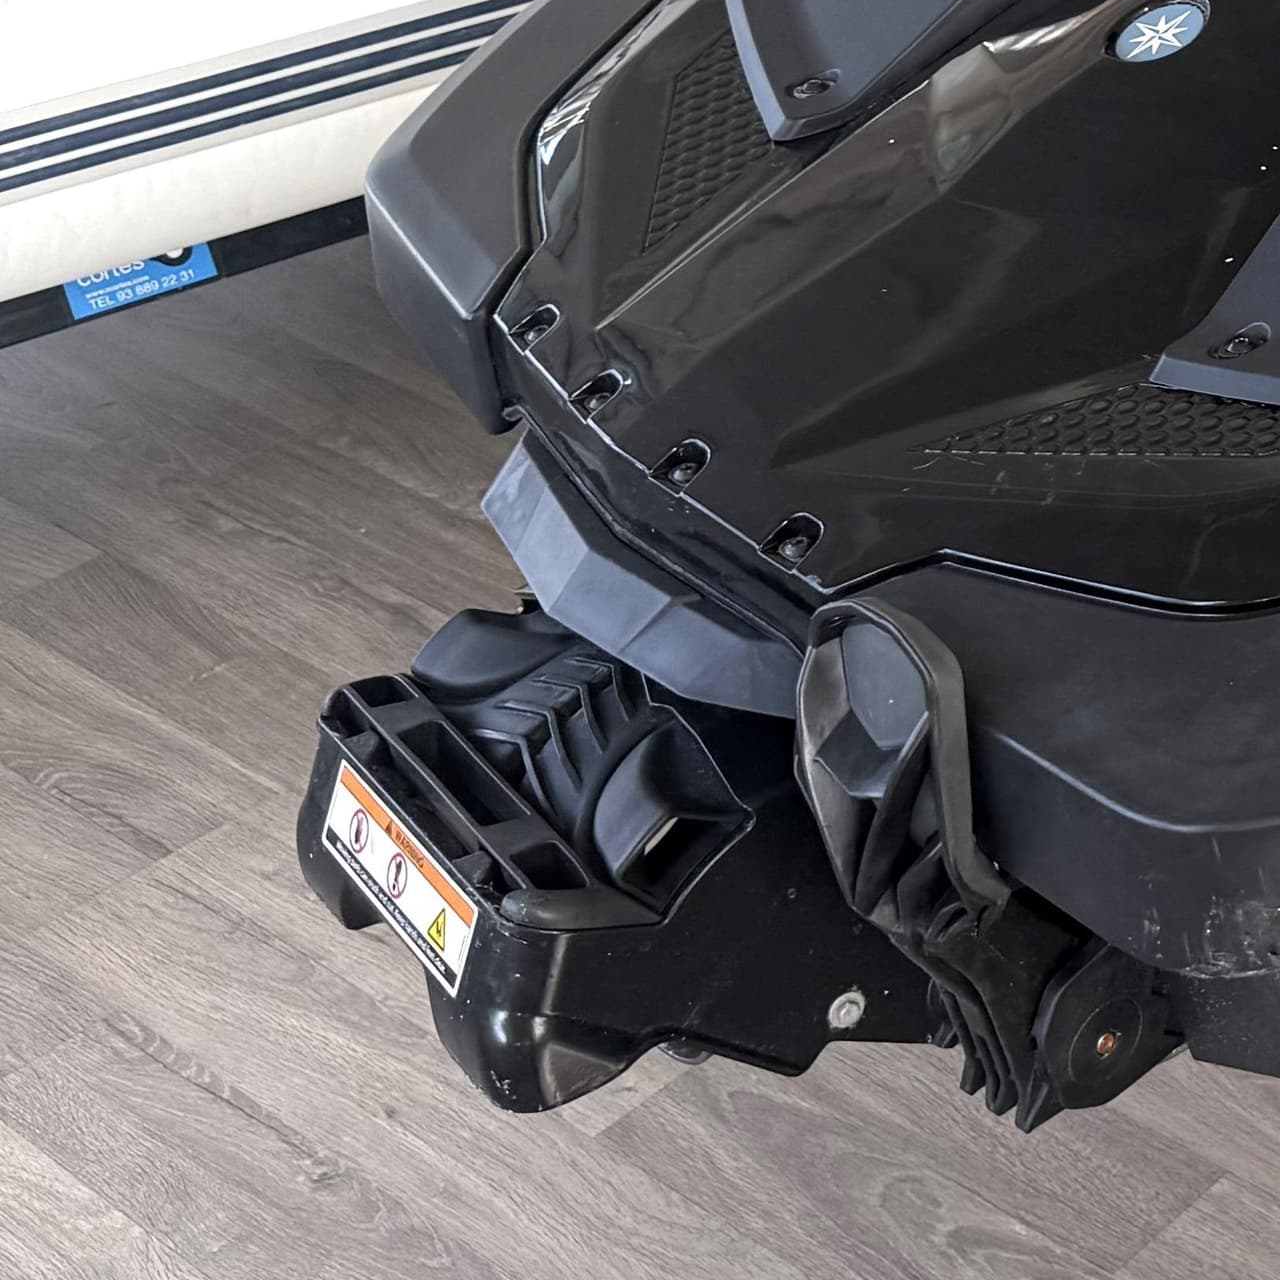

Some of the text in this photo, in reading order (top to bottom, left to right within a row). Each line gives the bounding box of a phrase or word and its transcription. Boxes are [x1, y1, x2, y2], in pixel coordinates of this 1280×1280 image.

[88, 294, 115, 311] TEL
[117, 288, 134, 303] 93
[162, 275, 179, 288] 22
[180, 268, 196, 283] 31
[394, 827, 426, 869] WARNING
